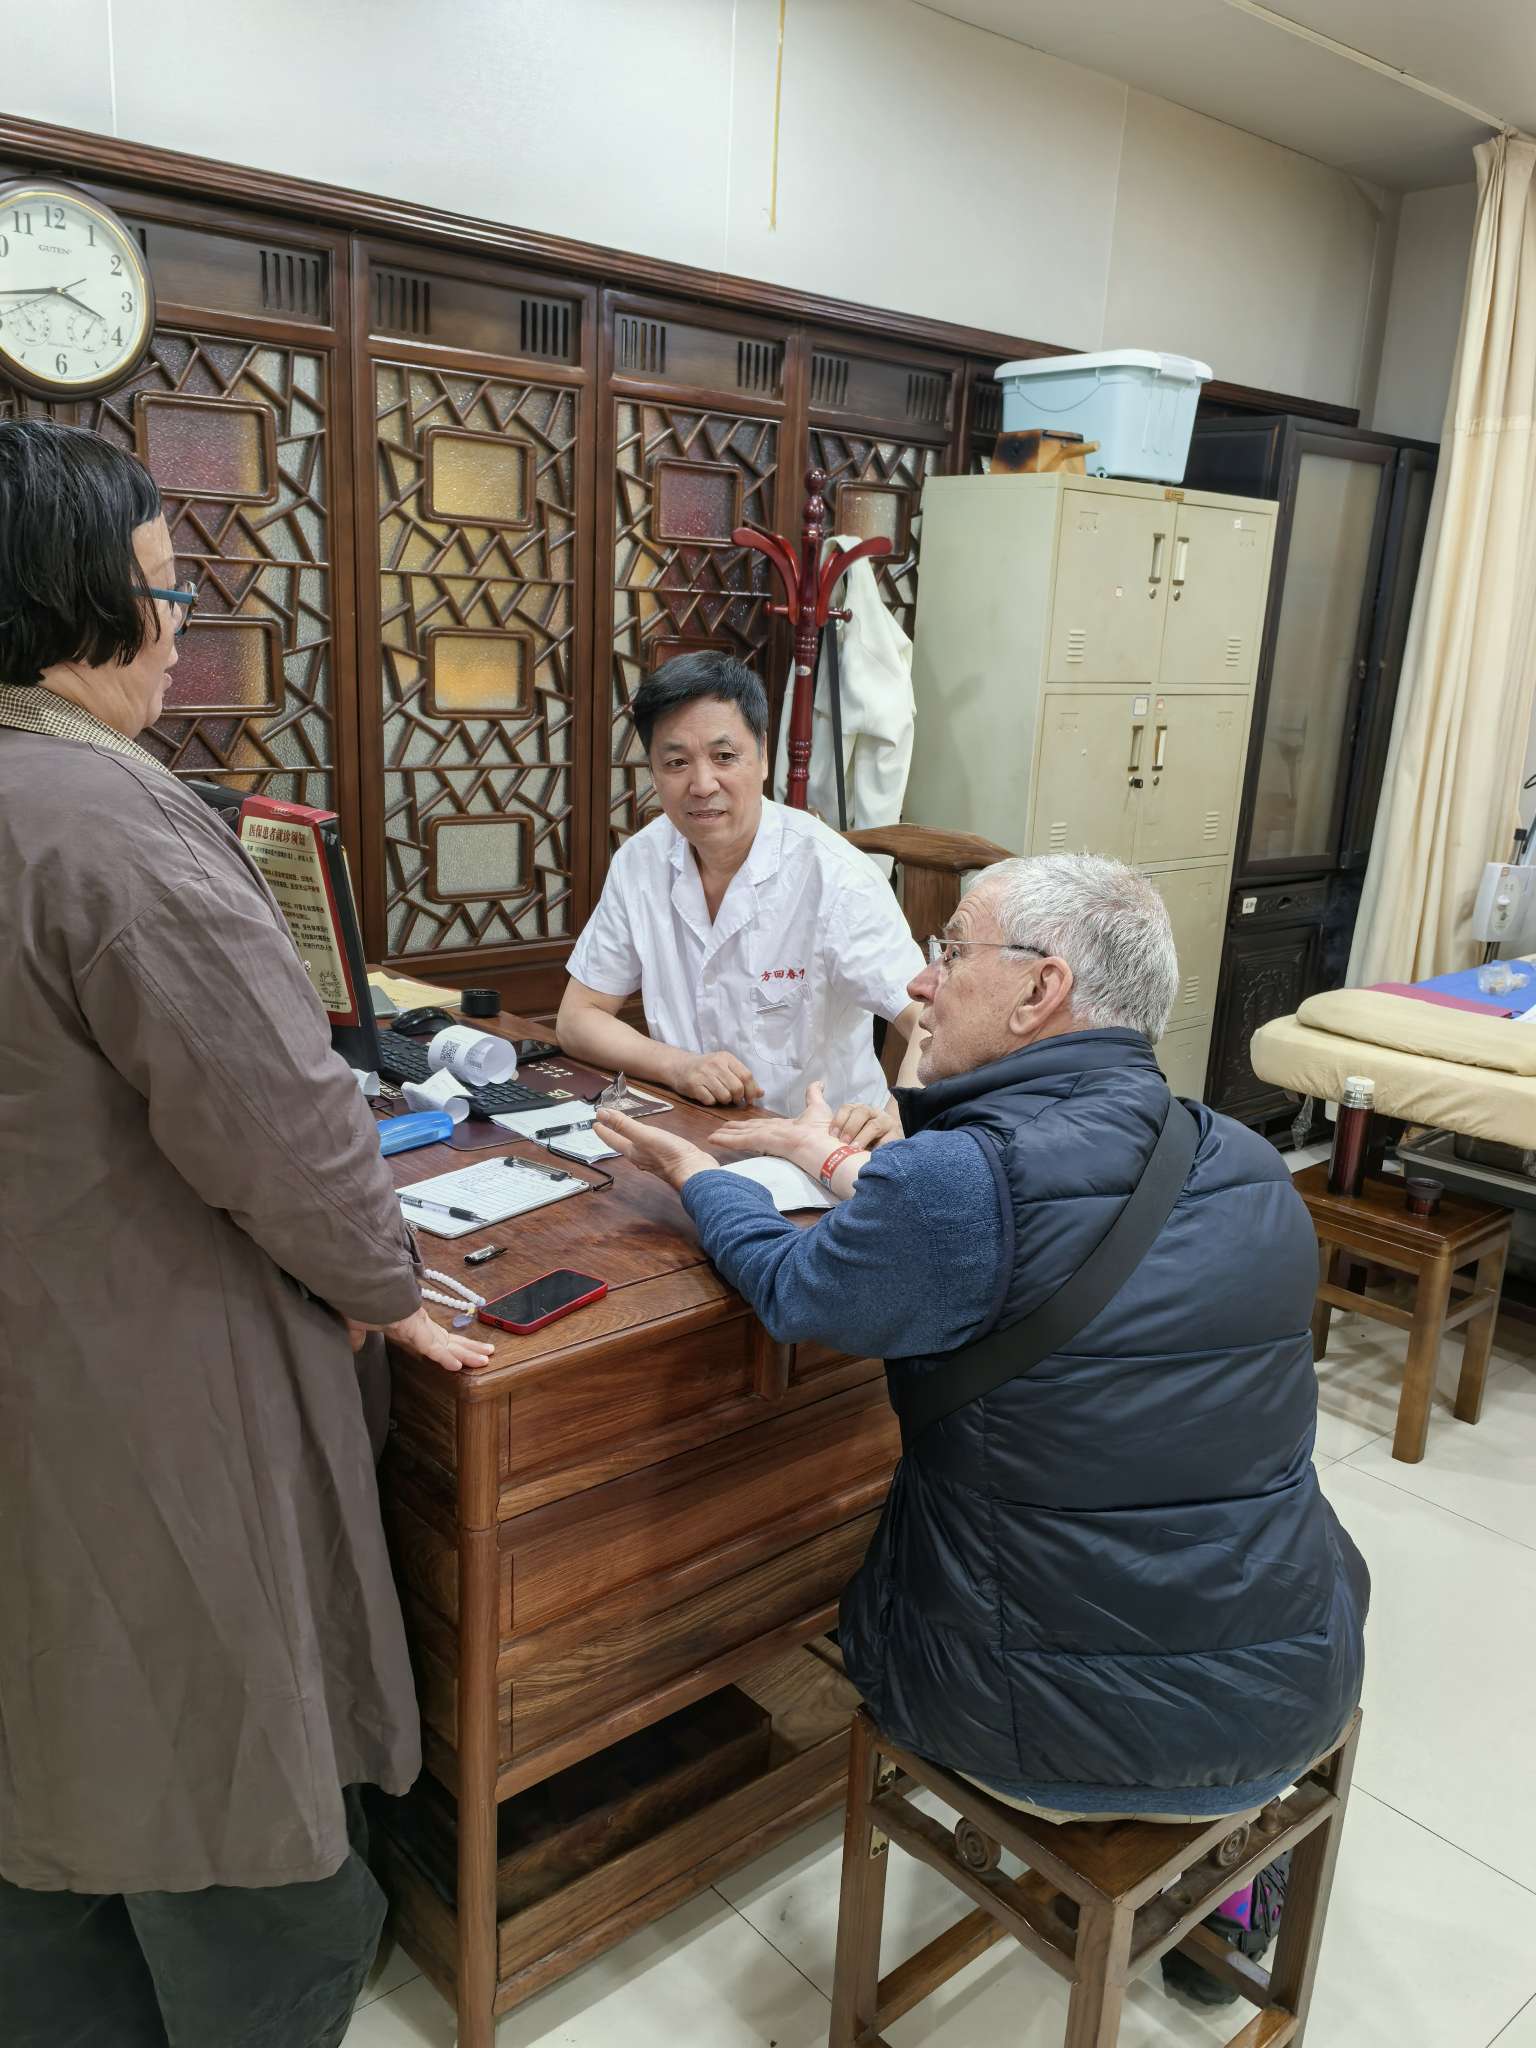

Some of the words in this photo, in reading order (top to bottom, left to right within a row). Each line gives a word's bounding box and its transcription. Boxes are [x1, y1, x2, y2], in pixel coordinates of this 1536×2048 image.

[13, 210, 34, 236] 11
[44, 205, 66, 230] 12
[88, 225, 97, 247] 1
[110, 254, 122, 276] 2
[121, 291, 133, 313] 3
[111, 326, 123, 347] 4
[56, 353, 68, 375] 6
